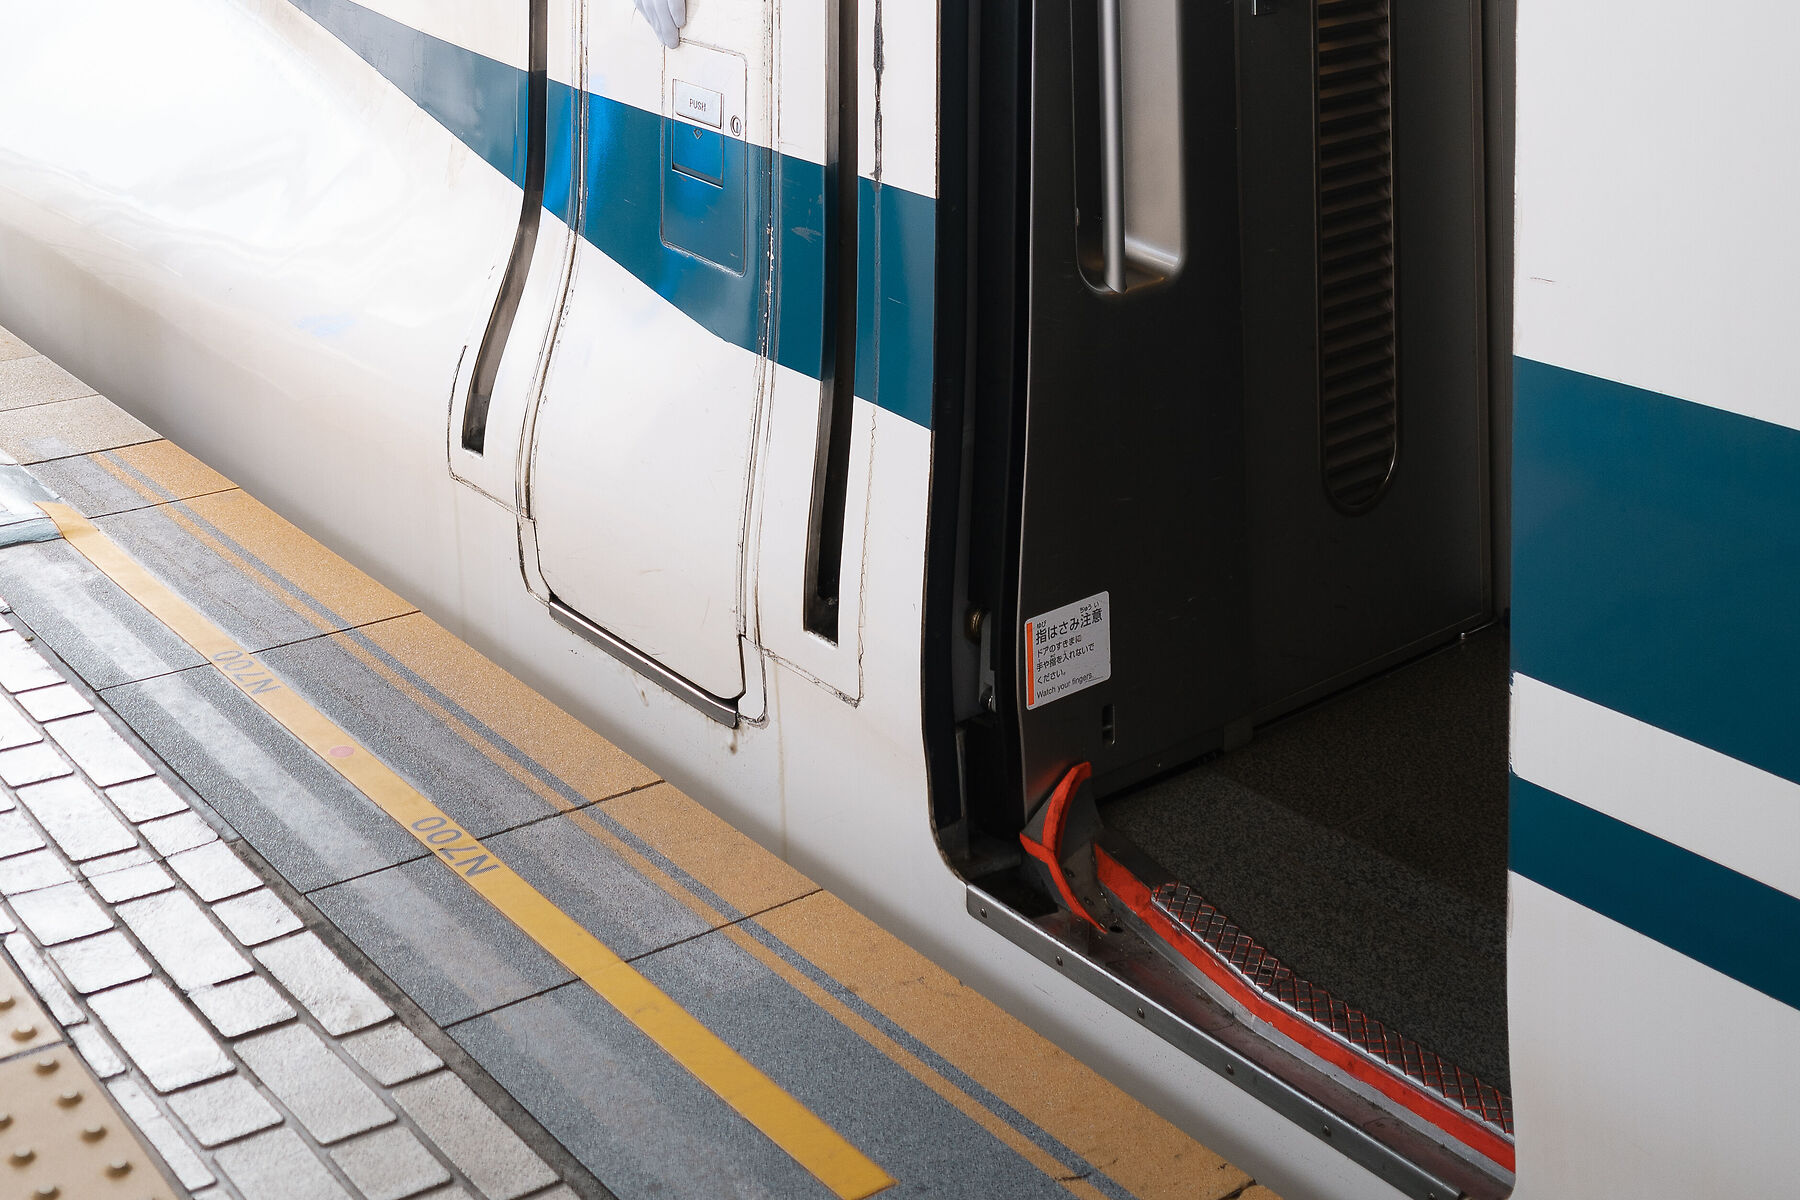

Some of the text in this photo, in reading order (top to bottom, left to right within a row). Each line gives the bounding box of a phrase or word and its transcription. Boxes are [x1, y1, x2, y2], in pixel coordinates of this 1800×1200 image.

[689, 98, 707, 112] PUSH
[1036, 608, 1103, 645] 指はさみ注意
[1037, 634, 1082, 658] ドアのすきまに
[1037, 642, 1095, 672] 手や指を入れないで
[213, 650, 281, 696] N700
[1036, 686, 1056, 699] Watch
[1057, 680, 1071, 693] your
[411, 816, 499, 878] N700
